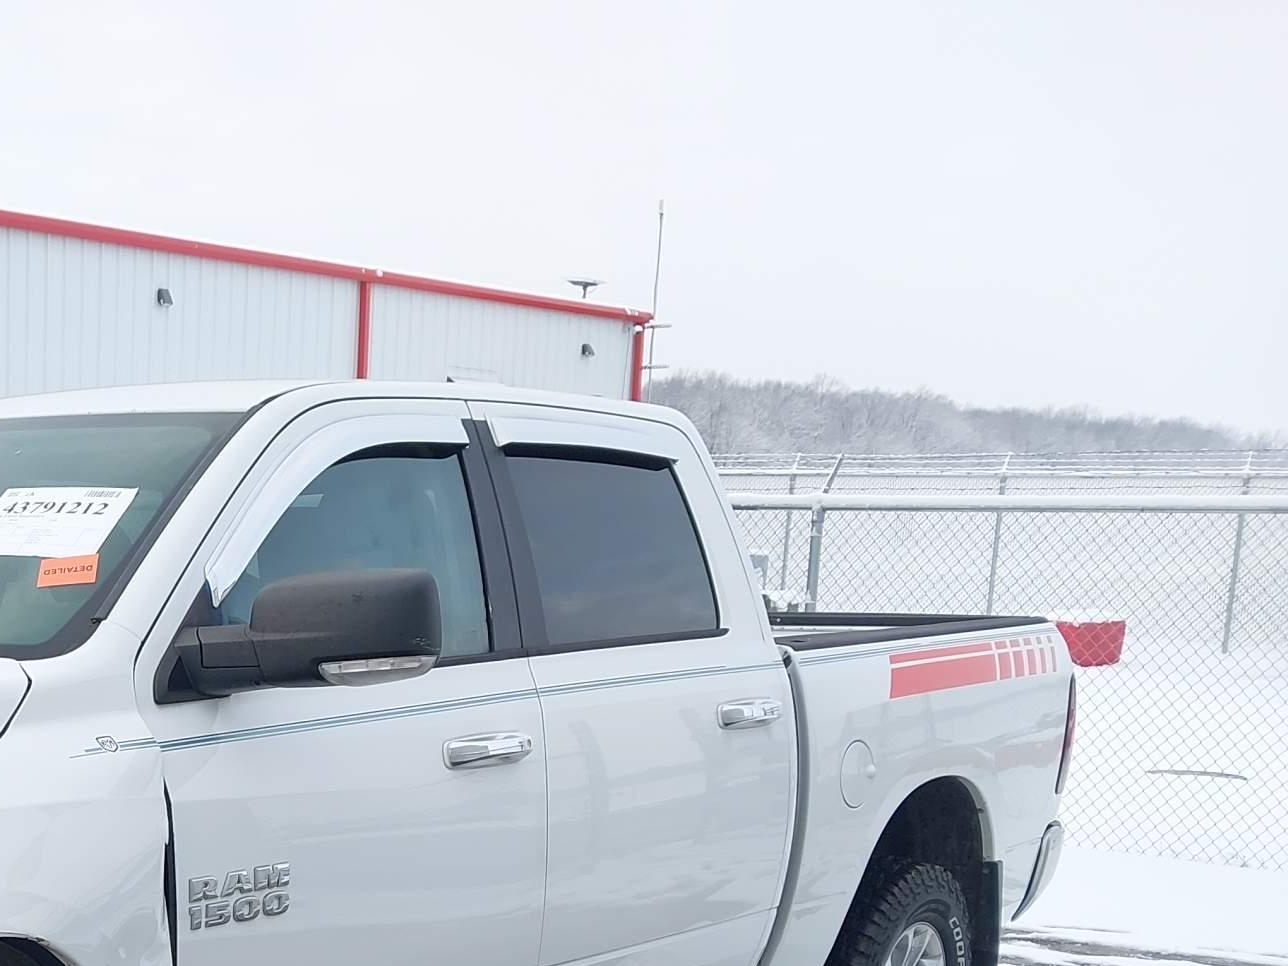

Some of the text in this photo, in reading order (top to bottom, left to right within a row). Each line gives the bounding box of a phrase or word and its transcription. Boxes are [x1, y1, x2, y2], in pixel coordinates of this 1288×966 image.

[2, 501, 110, 516] 43791212
[43, 563, 93, 576] DETAILED
[188, 861, 290, 904] RAM
[188, 889, 290, 931] 1500
